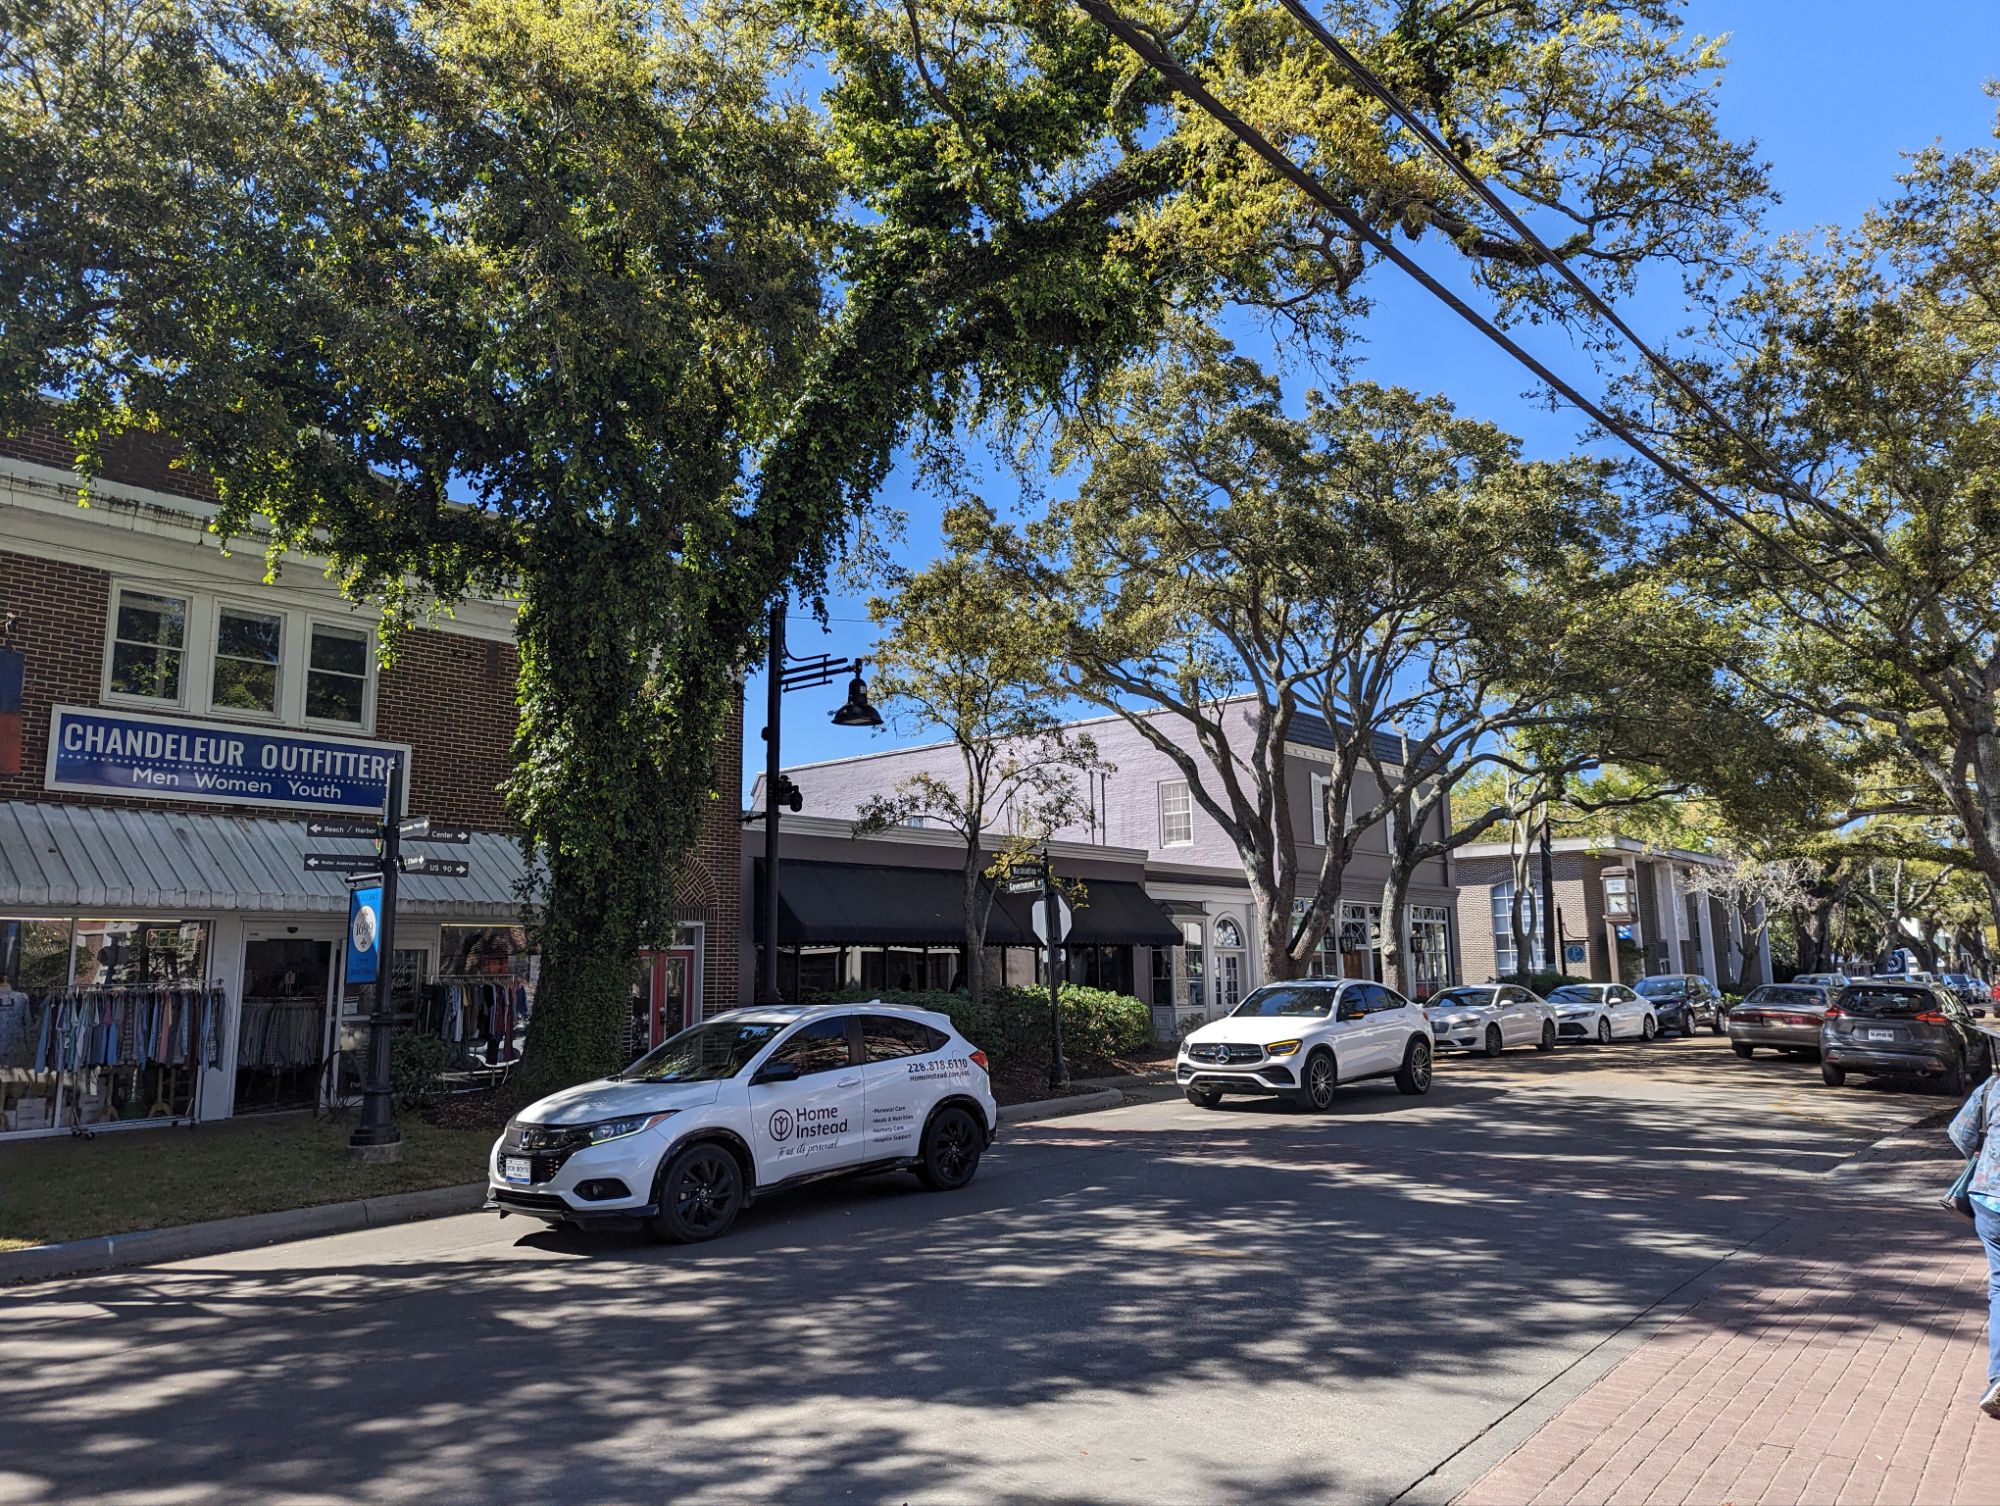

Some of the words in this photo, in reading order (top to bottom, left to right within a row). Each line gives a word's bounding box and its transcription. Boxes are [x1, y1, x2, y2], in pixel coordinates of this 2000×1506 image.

[64, 723, 245, 767] CHANDELEUR
[133, 767, 179, 786] Men
[194, 772, 272, 794] Women
[288, 780, 341, 799] Youth
[431, 831, 453, 839] Center
[429, 864, 439, 872] US
[442, 865, 452, 873] 90
[906, 1058, 968, 1073] 228.818.6110
[796, 1106, 838, 1122] Home
[892, 1133, 912, 1141] Support
